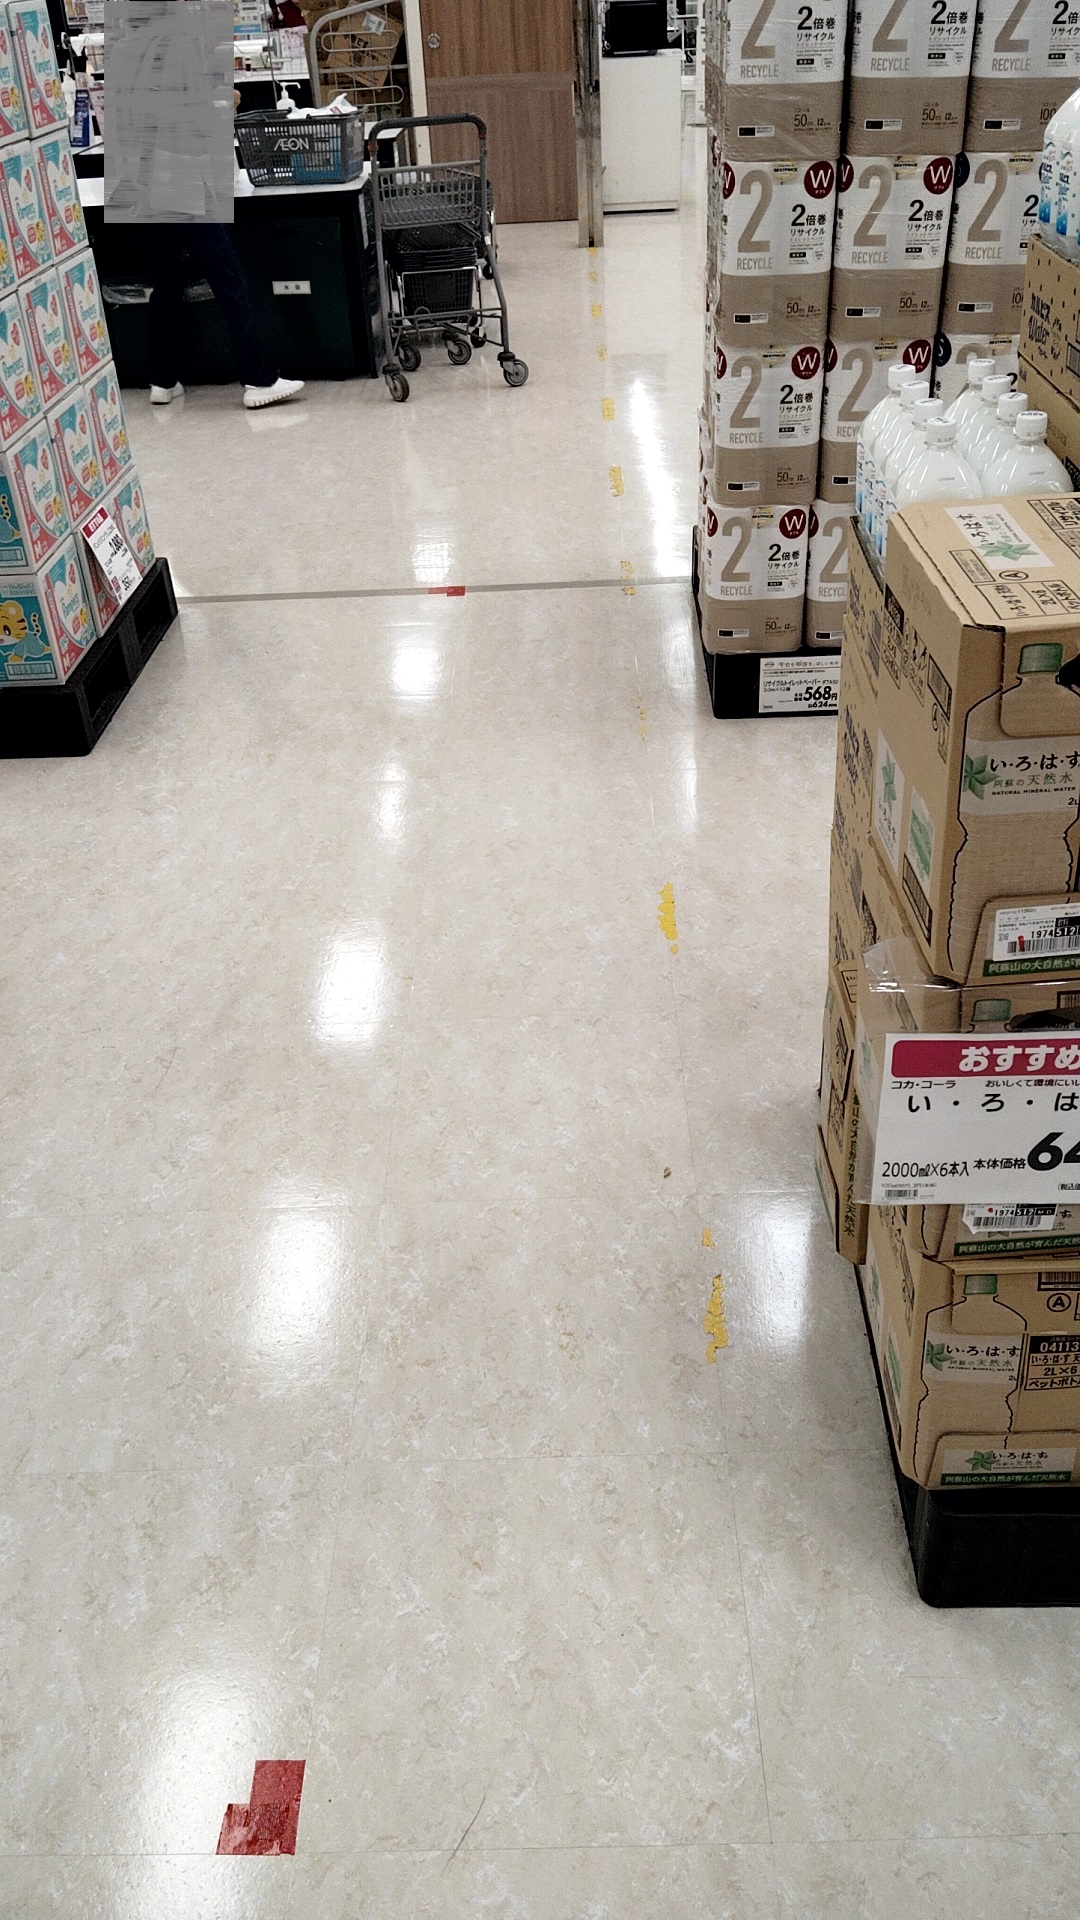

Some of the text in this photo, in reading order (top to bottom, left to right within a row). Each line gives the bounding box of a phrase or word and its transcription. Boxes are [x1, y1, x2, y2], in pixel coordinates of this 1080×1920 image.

[797, 6, 836, 30] 2倍巻
[930, 0, 968, 24] 2倍巻
[1052, 0, 1080, 24] 2倍
[741, 0, 775, 59] 2
[872, 0, 908, 52] 2
[929, 26, 967, 35] リサイクル
[994, 0, 1031, 52] 2
[796, 32, 835, 41] リサイクル
[740, 64, 779, 78] RECYCLE
[870, 58, 910, 71] RECYCLE
[992, 58, 1031, 71] RECYCLE
[810, 169, 831, 188] W
[930, 165, 951, 184] W
[853, 165, 892, 246] 2
[967, 159, 1008, 241] 2
[738, 170, 773, 253] 2
[791, 204, 826, 226] 2倍巻
[908, 199, 944, 221] 2倍巻
[790, 228, 825, 236] リサイクル
[852, 251, 888, 263] RECYCLE
[965, 247, 1002, 259] RECYCLE
[737, 257, 773, 270] RECYCLE
[797, 353, 817, 370] W
[909, 346, 929, 364] W
[730, 356, 762, 428] 2
[780, 384, 813, 404] 2倍巻
[838, 349, 873, 421] 2
[730, 433, 763, 443] RECYCLE
[837, 427, 860, 437] RECY
[71, 444, 90, 467] Pampers
[32, 480, 53, 504] Pampers
[784, 514, 804, 531] W
[721, 516, 752, 582] 2
[768, 543, 800, 561] 2倍巻
[820, 517, 849, 583] 2
[721, 586, 752, 596] RECYCLE
[819, 587, 846, 597] RECYCL
[990, 751, 1080, 772] い・ろ・は・す
[993, 772, 1073, 788] 阿蘇の天然水
[959, 1045, 1080, 1073] おすすめ
[890, 1080, 957, 1090] コカ・コーラ
[973, 1158, 1026, 1170] 本体価格
[1052, 1296, 1065, 1308] A
[947, 1345, 1020, 1357] い・ろ・は・す
[1031, 1354, 1070, 1364] い・ろ・は・す
[945, 1474, 1066, 1483] 阿蘇山の大自然が育んだ天然水
